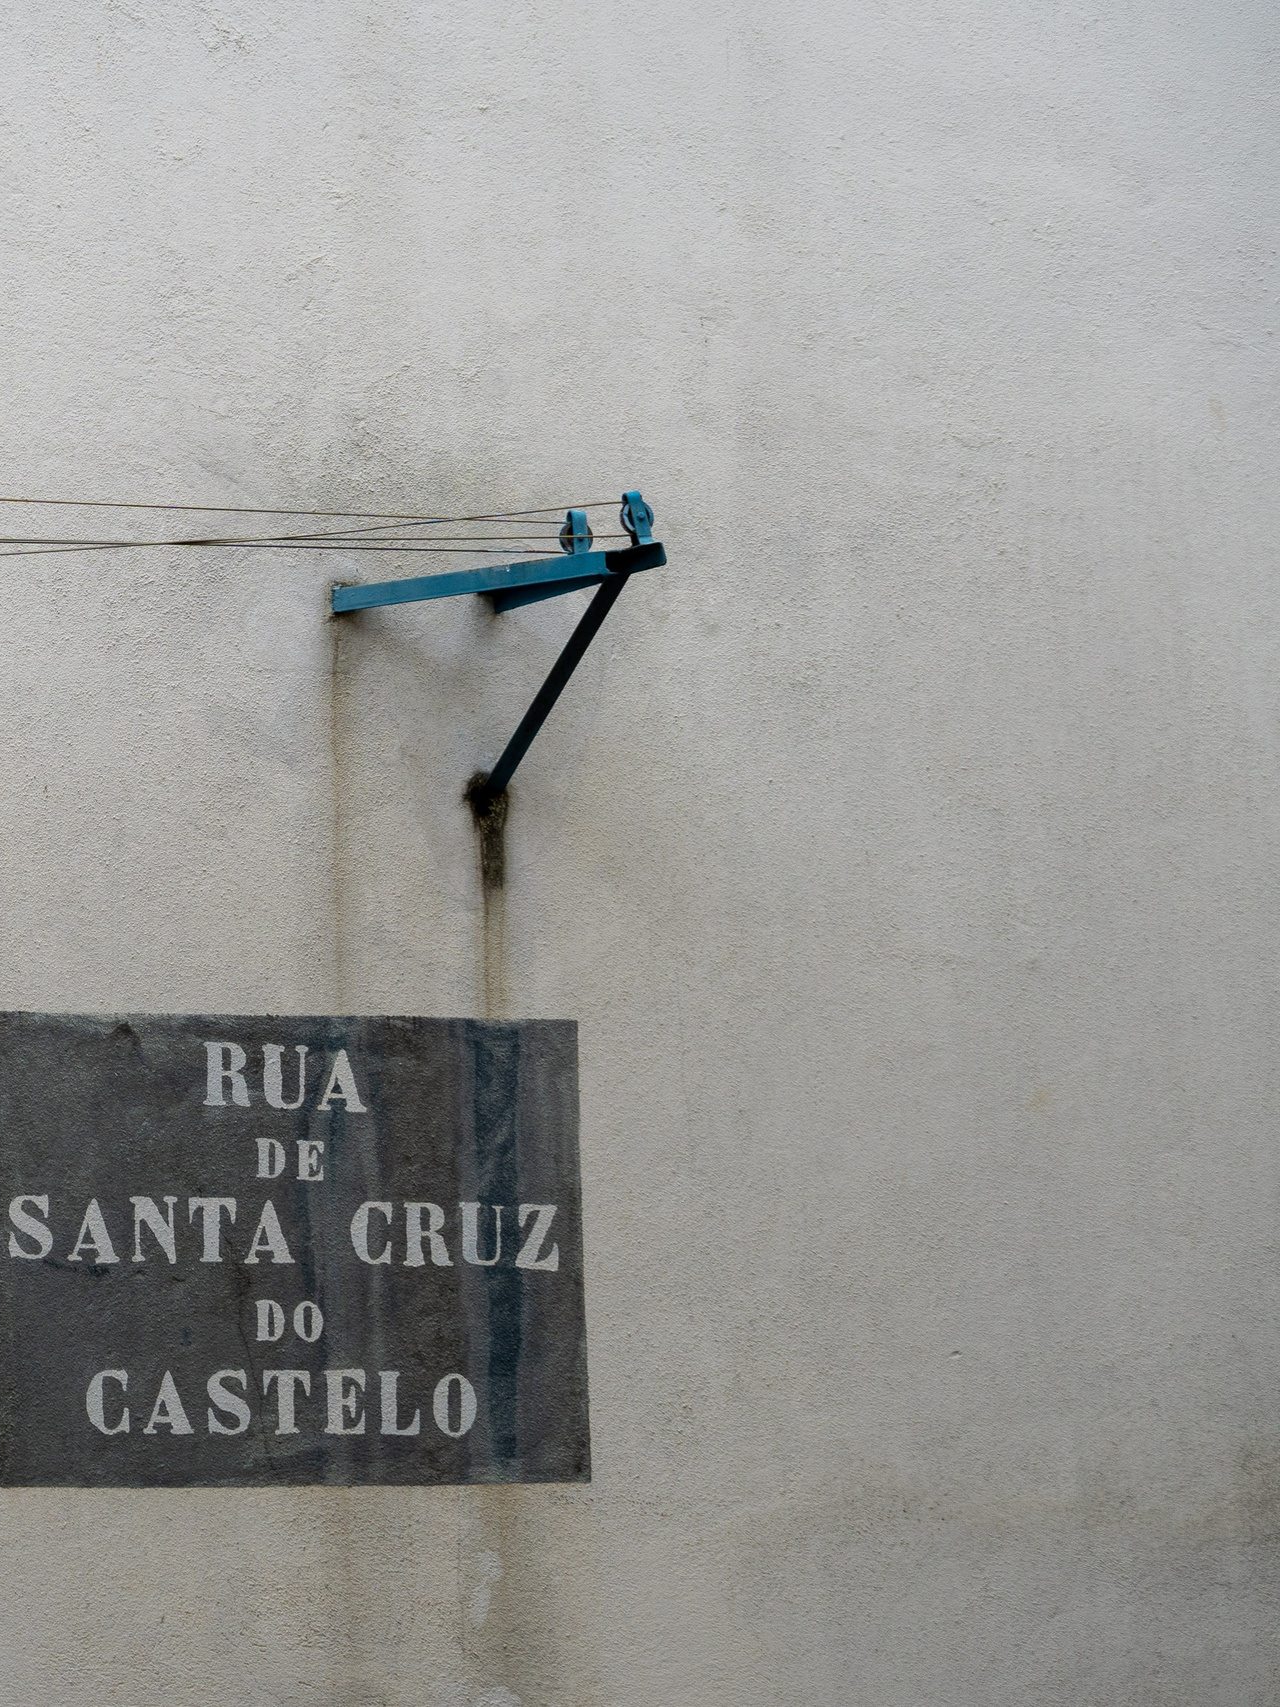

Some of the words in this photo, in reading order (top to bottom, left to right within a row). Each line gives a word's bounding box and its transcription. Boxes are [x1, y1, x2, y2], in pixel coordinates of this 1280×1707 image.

[202, 1041, 368, 1113] RUA
[254, 1138, 325, 1181] DE
[7, 1194, 296, 1264] SANTA
[349, 1201, 560, 1272] CRUZ
[254, 1299, 324, 1342] DO
[85, 1368, 478, 1437] CASTELO
